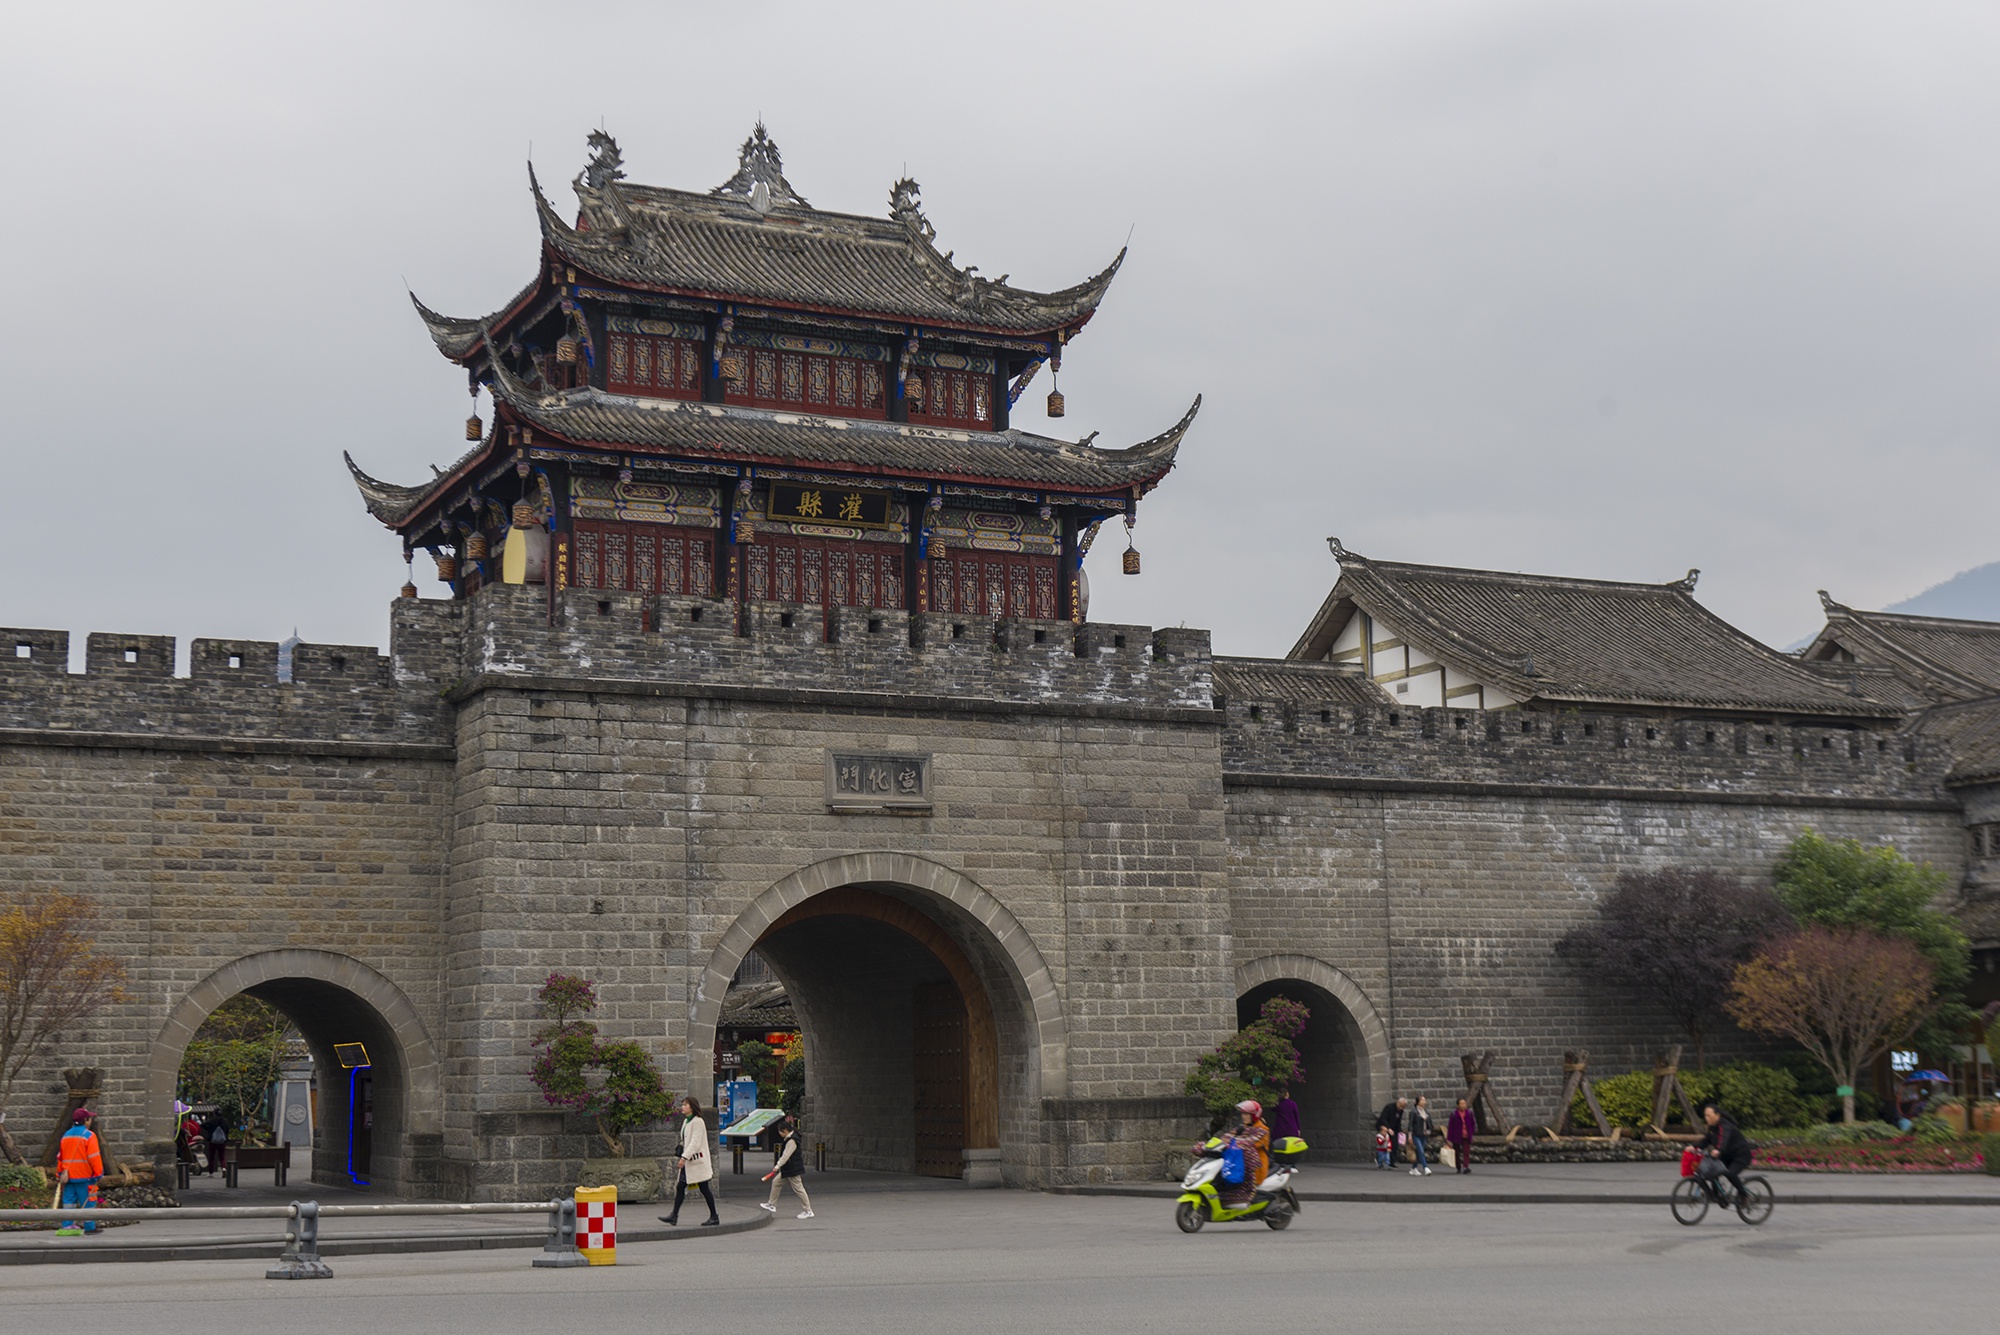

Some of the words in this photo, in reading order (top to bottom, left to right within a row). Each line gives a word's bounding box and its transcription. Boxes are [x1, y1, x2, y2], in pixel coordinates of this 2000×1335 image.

[795, 490, 865, 521] 灌縣
[841, 765, 917, 793] 宣化門
